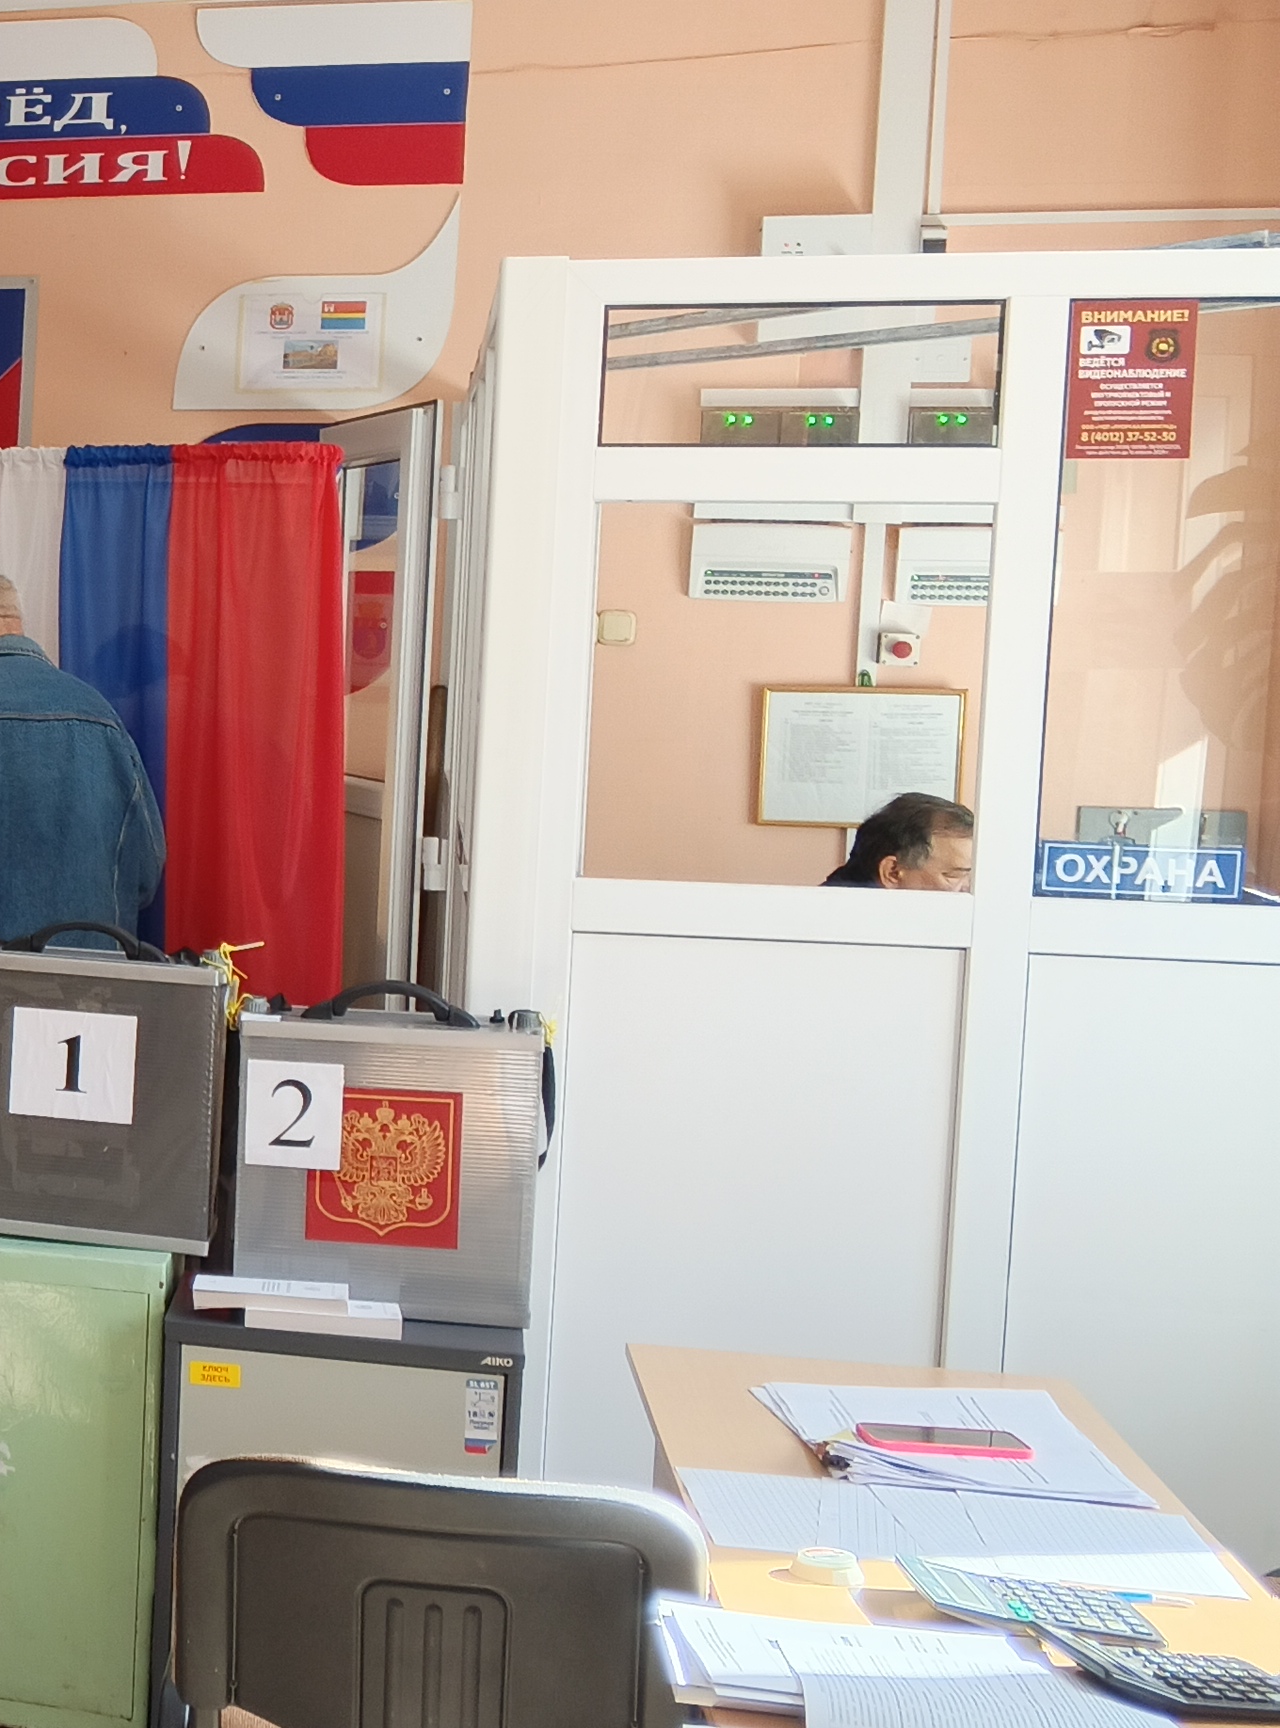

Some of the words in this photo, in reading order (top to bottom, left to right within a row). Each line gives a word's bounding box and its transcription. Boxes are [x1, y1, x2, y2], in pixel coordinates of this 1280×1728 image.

[1081, 309, 1190, 323] ВНИМАНИЕ!
[1078, 356, 1126, 367] ВЕДЁТСЯ
[1078, 368, 1187, 379] ВИДЕОНАБЛЮДЕНИЕ
[1081, 432, 1089, 441] 8
[1090, 431, 1124, 443] (4012)
[1054, 853, 1226, 889] ОХРАНА
[55, 1034, 87, 1094] 1
[268, 1078, 316, 1148] 2
[480, 1356, 514, 1367] AIKO
[202, 1365, 229, 1374] КЛЮЧ
[200, 1374, 231, 1383] ЗДЕСЬ
